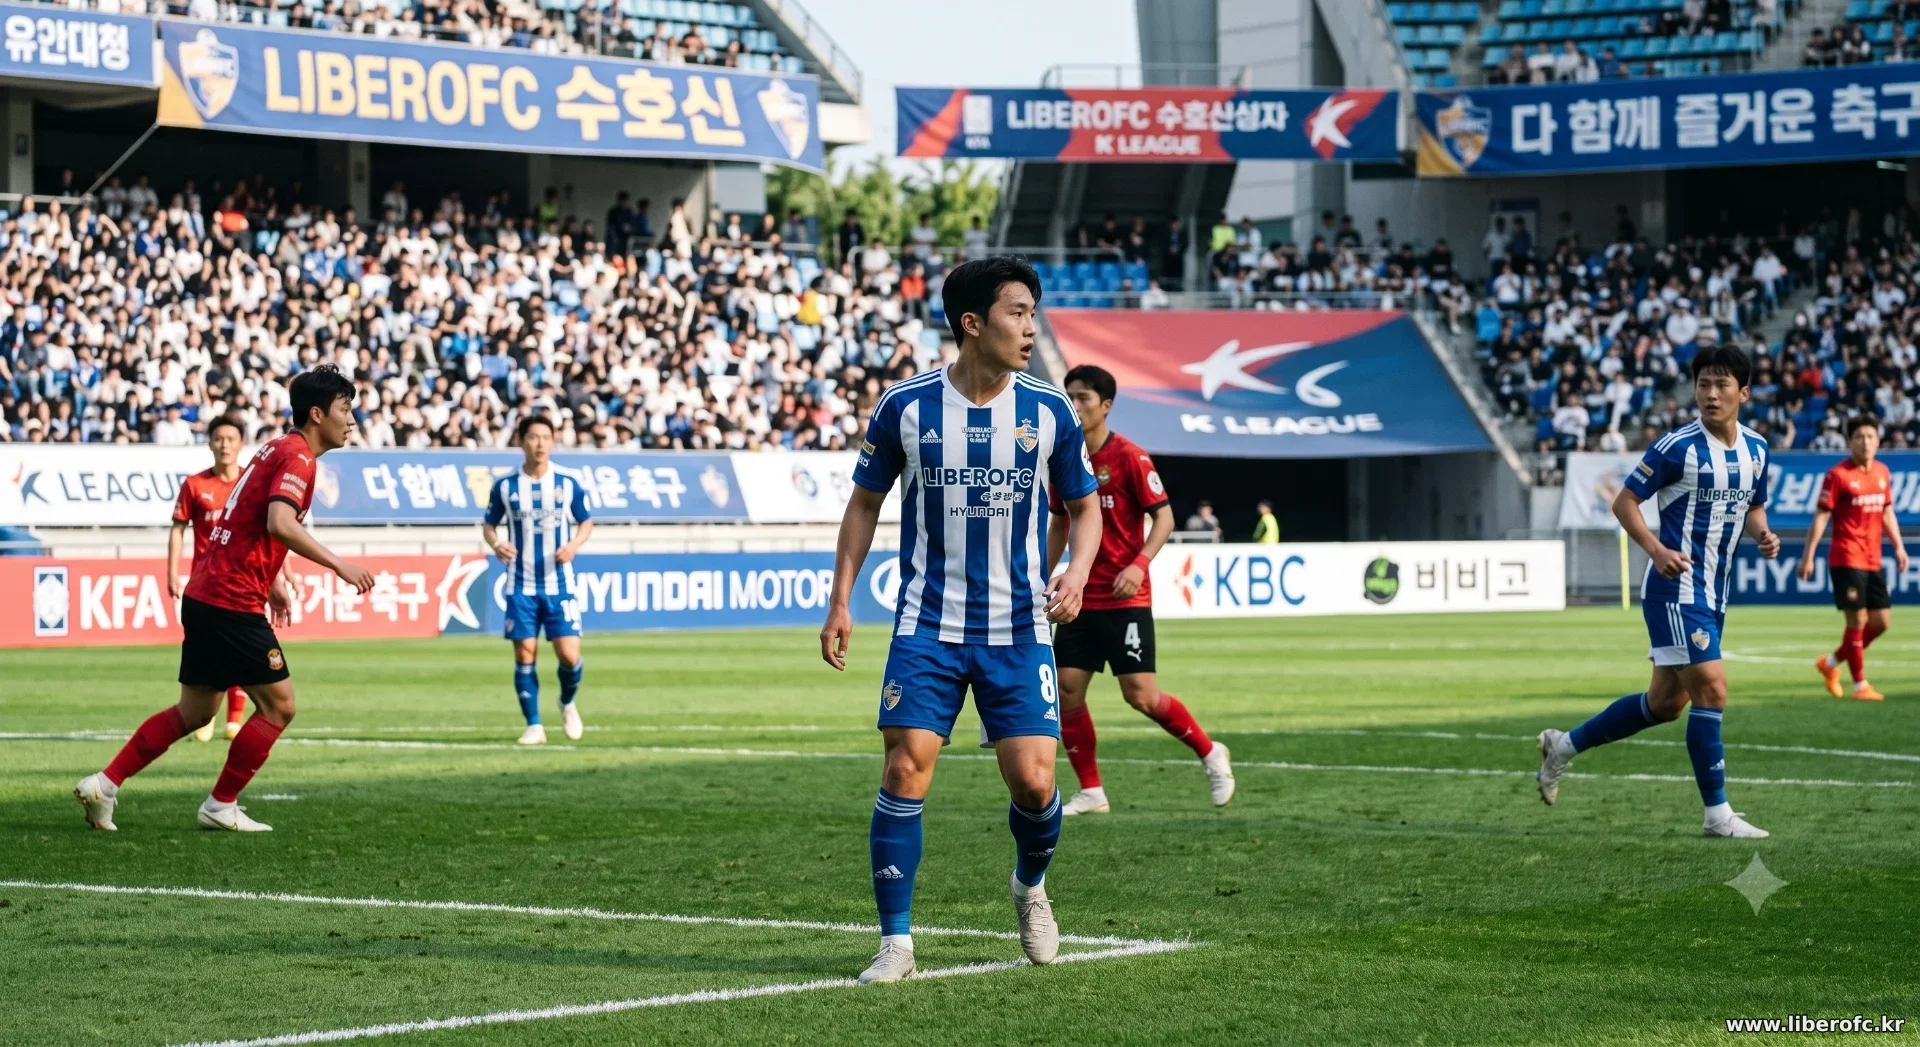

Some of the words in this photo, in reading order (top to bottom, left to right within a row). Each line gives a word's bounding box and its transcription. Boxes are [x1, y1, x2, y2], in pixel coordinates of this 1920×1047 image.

[264, 47, 541, 131] LIBEROFC
[556, 65, 747, 147] 수호신
[1007, 100, 1151, 130] LIBEROFC
[1511, 101, 1557, 155] 다
[1568, 96, 1661, 154] 함께
[1674, 88, 1816, 148] 즐거운
[1831, 81, 1920, 139] 축구
[1095, 134, 1114, 155] K
[1118, 134, 1201, 156] LEAGUE
[1180, 413, 1217, 434] K
[1223, 413, 1383, 435] LEAGUE
[224, 464, 256, 521] 4
[362, 463, 400, 509] 다
[627, 464, 687, 509] 축구
[923, 467, 1034, 489] LIBEROFC
[950, 506, 1010, 518] HYUNDAI
[369, 570, 429, 622] 축구
[1215, 554, 1307, 607] KBC
[1416, 557, 1529, 601] 비비고
[80, 575, 168, 630] KFA
[1125, 622, 1141, 649] 4
[1039, 664, 1056, 704] 8
